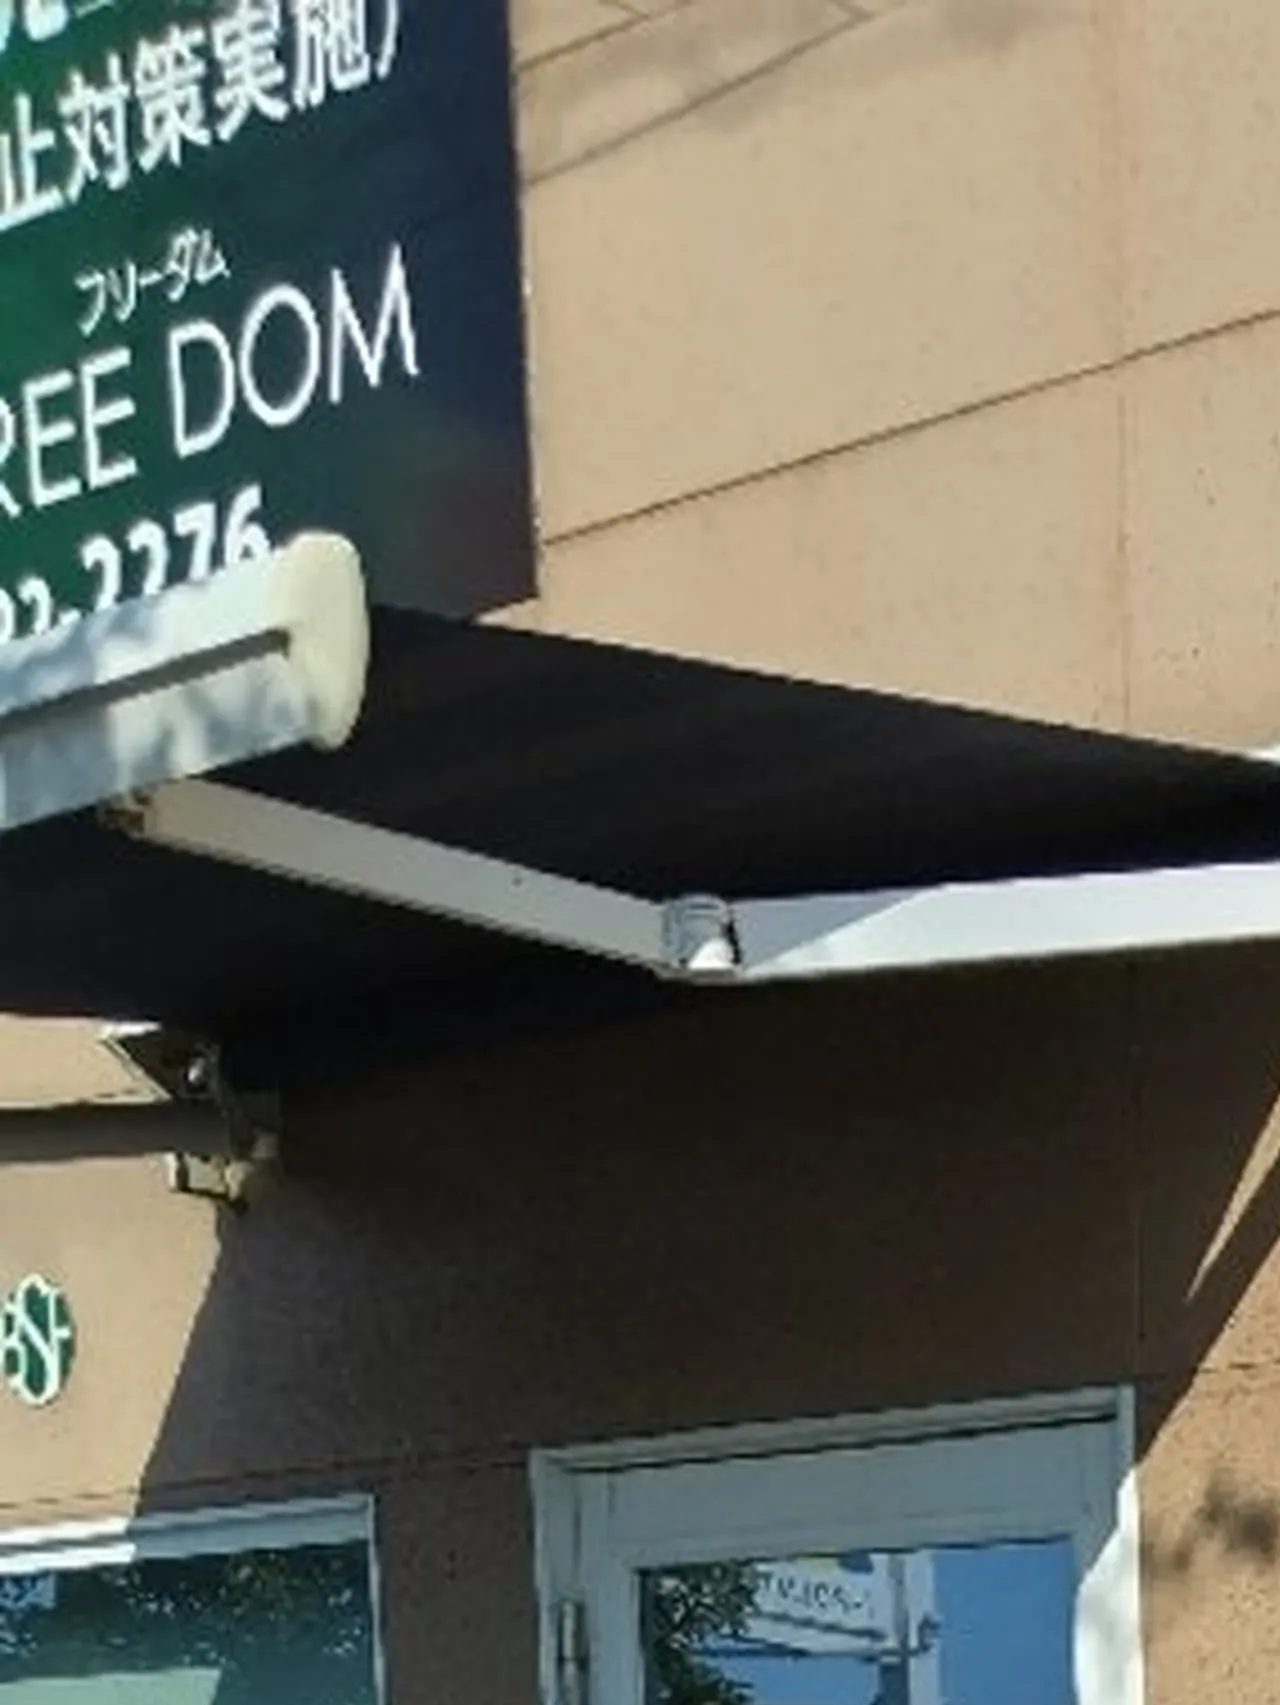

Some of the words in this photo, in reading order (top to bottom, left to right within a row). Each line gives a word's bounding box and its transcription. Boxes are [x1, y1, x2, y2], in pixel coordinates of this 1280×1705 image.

[75, 228, 232, 338] フリーダム
[168, 242, 420, 457] DOM
